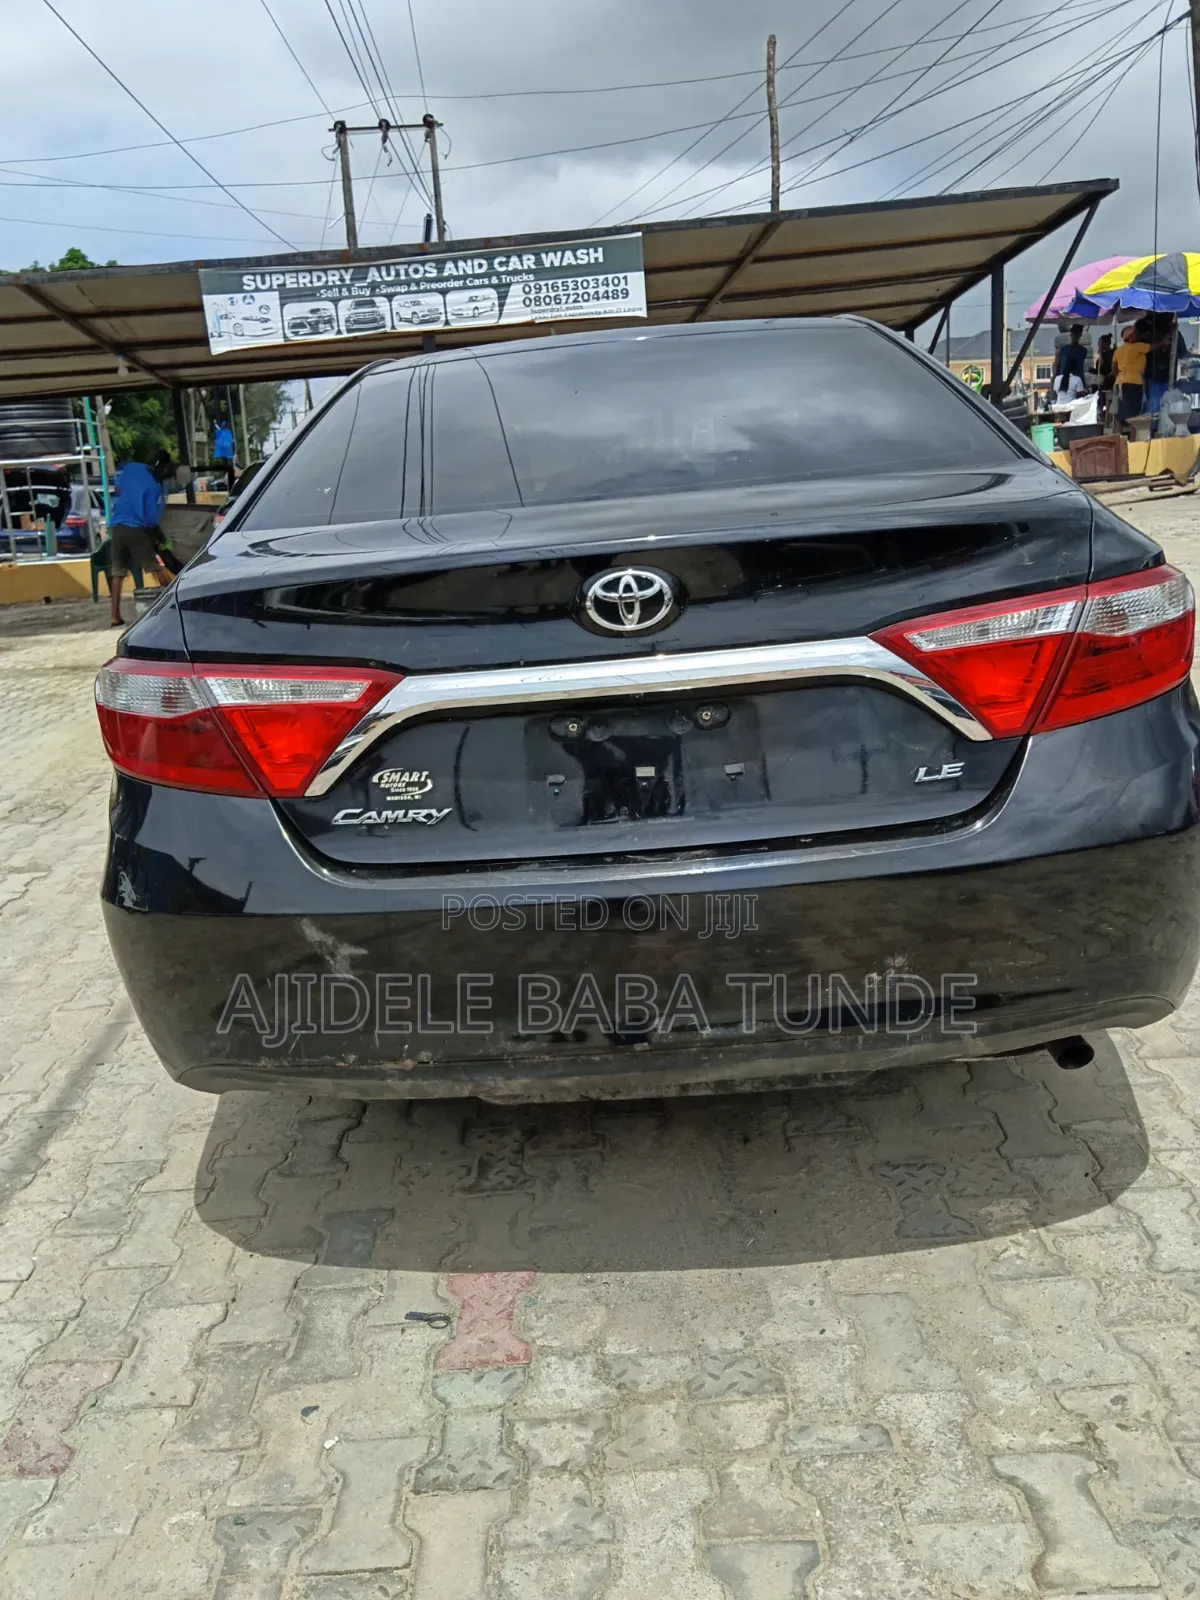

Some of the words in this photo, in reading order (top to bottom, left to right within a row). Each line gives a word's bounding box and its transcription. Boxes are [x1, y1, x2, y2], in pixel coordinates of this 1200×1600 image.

[443, 258, 489, 277] AND
[493, 253, 537, 272] CAR
[541, 247, 604, 267] WASH
[319, 288, 340, 298] Sell
[342, 287, 350, 296] &
[351, 285, 372, 297] Buy
[380, 284, 408, 296] Swap
[410, 283, 419, 291] &
[420, 279, 465, 291] Preorder
[466, 276, 491, 286] Cars
[491, 275, 500, 284] &
[500, 272, 535, 283] Trucks
[523, 275, 629, 295] 09165303401
[523, 288, 629, 307] 08067204489
[380, 771, 429, 783] SMART
[914, 761, 966, 783] LE
[331, 807, 453, 826] CAMRY
